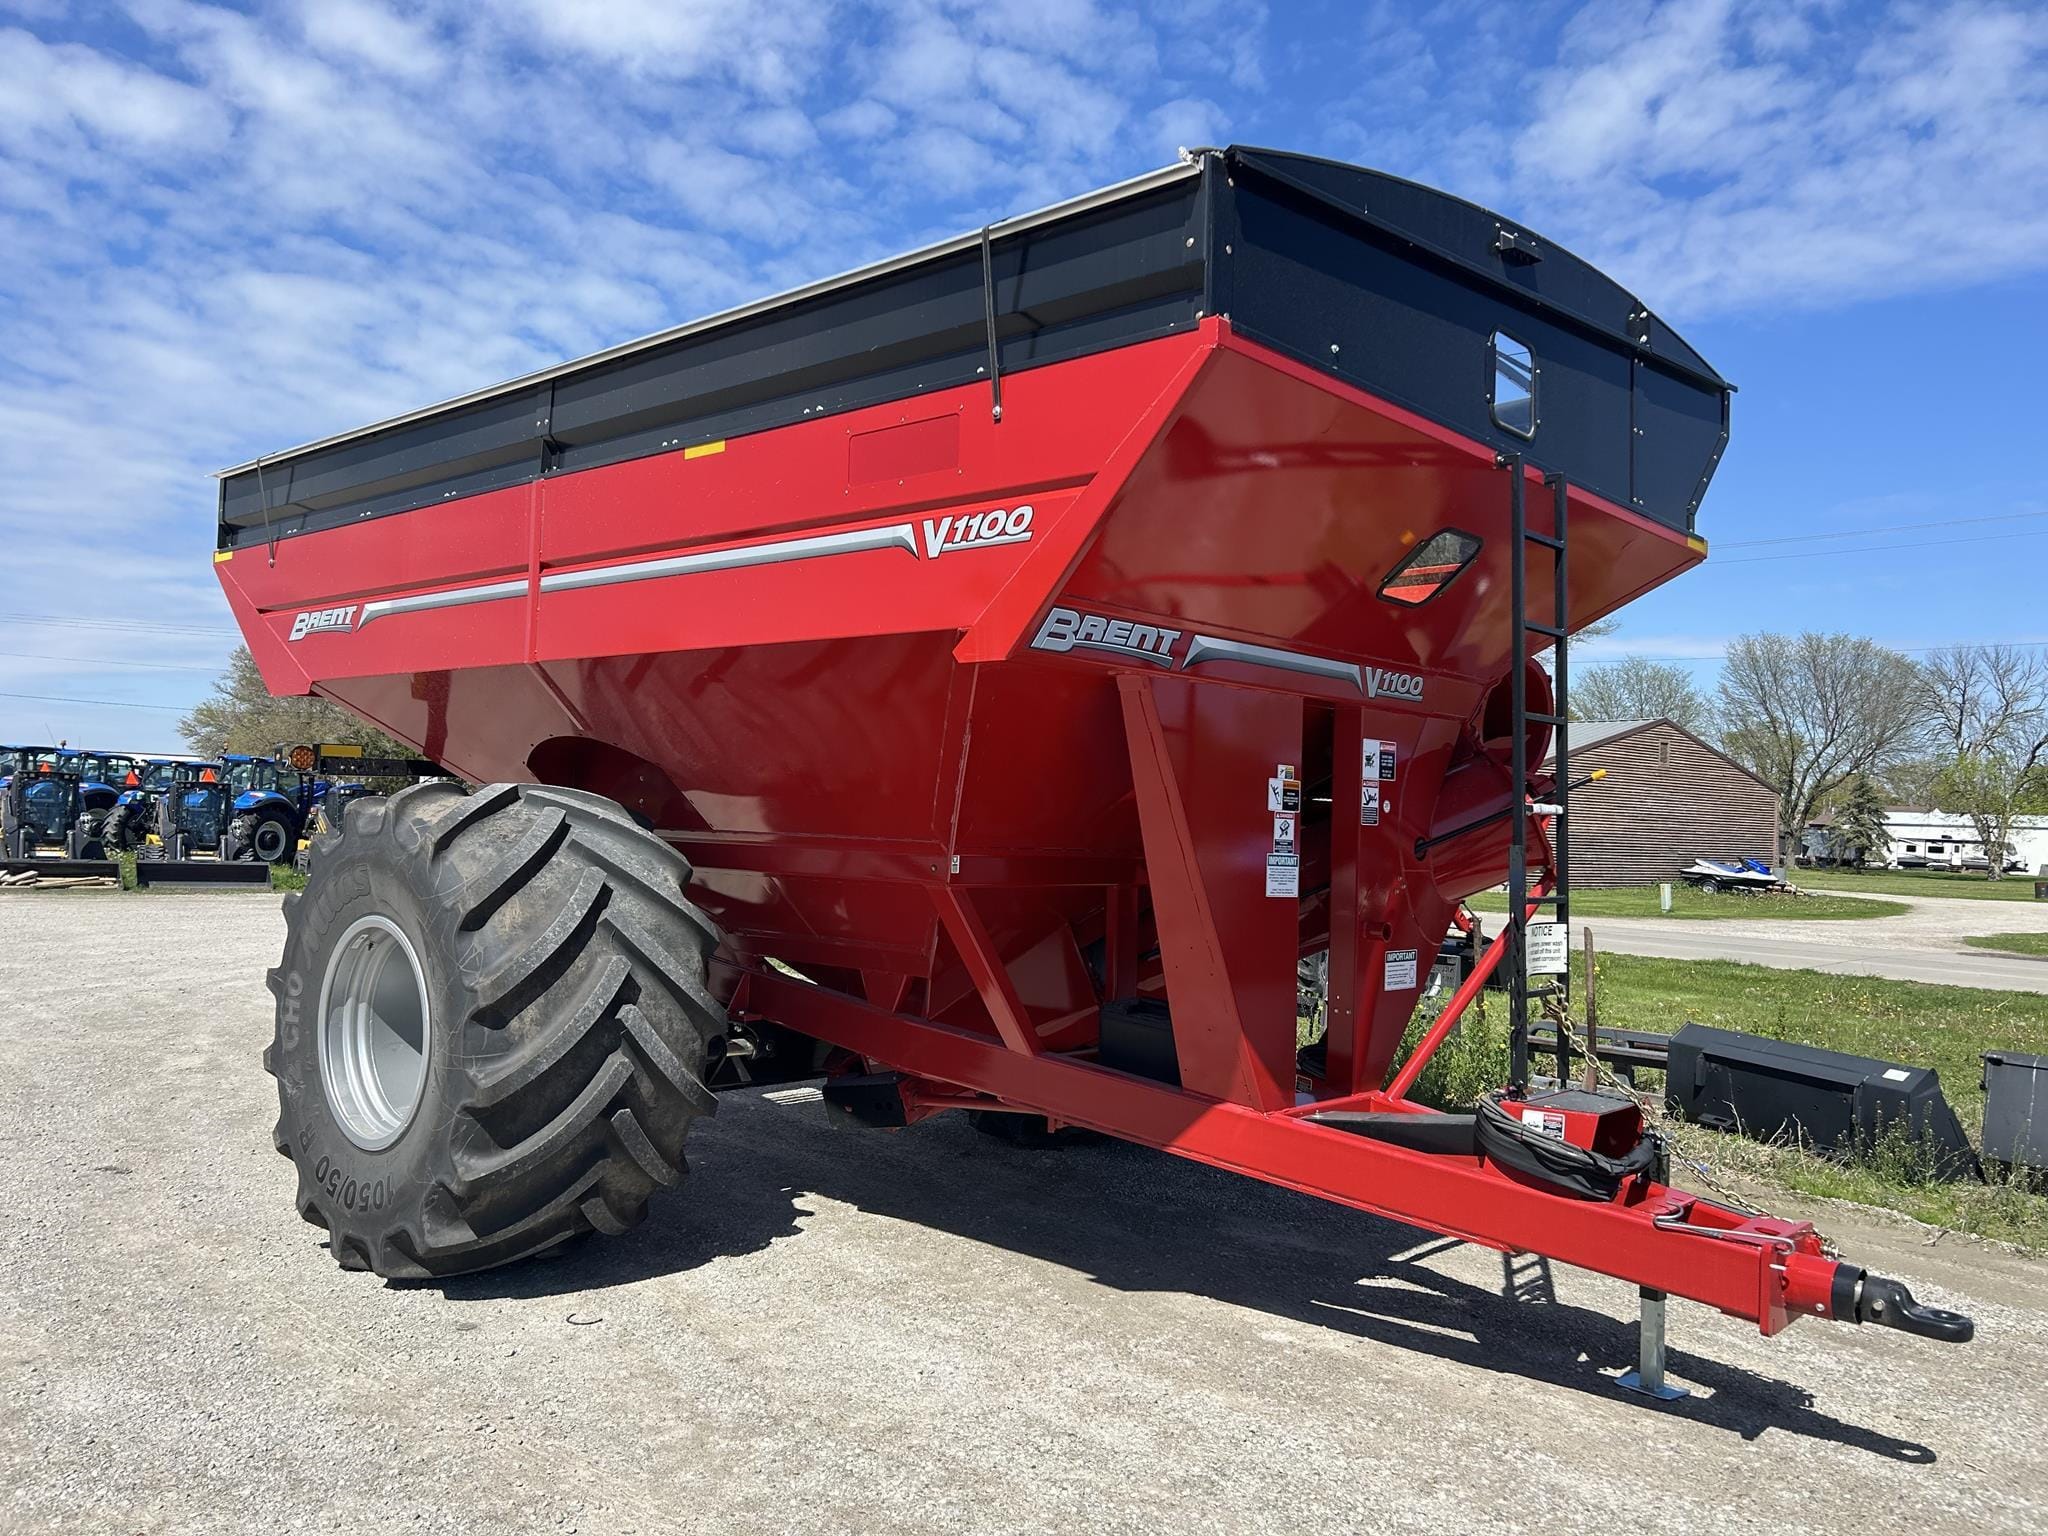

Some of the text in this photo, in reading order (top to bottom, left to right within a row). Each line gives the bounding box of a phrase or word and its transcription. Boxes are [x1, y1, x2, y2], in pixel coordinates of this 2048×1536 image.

[923, 505, 1034, 559] V1100
[1364, 666, 1424, 699] V1100
[1531, 925, 1553, 937] NOTICE
[1387, 951, 1416, 961] IMPORTANT
[315, 1155, 395, 1212] 1050/50
